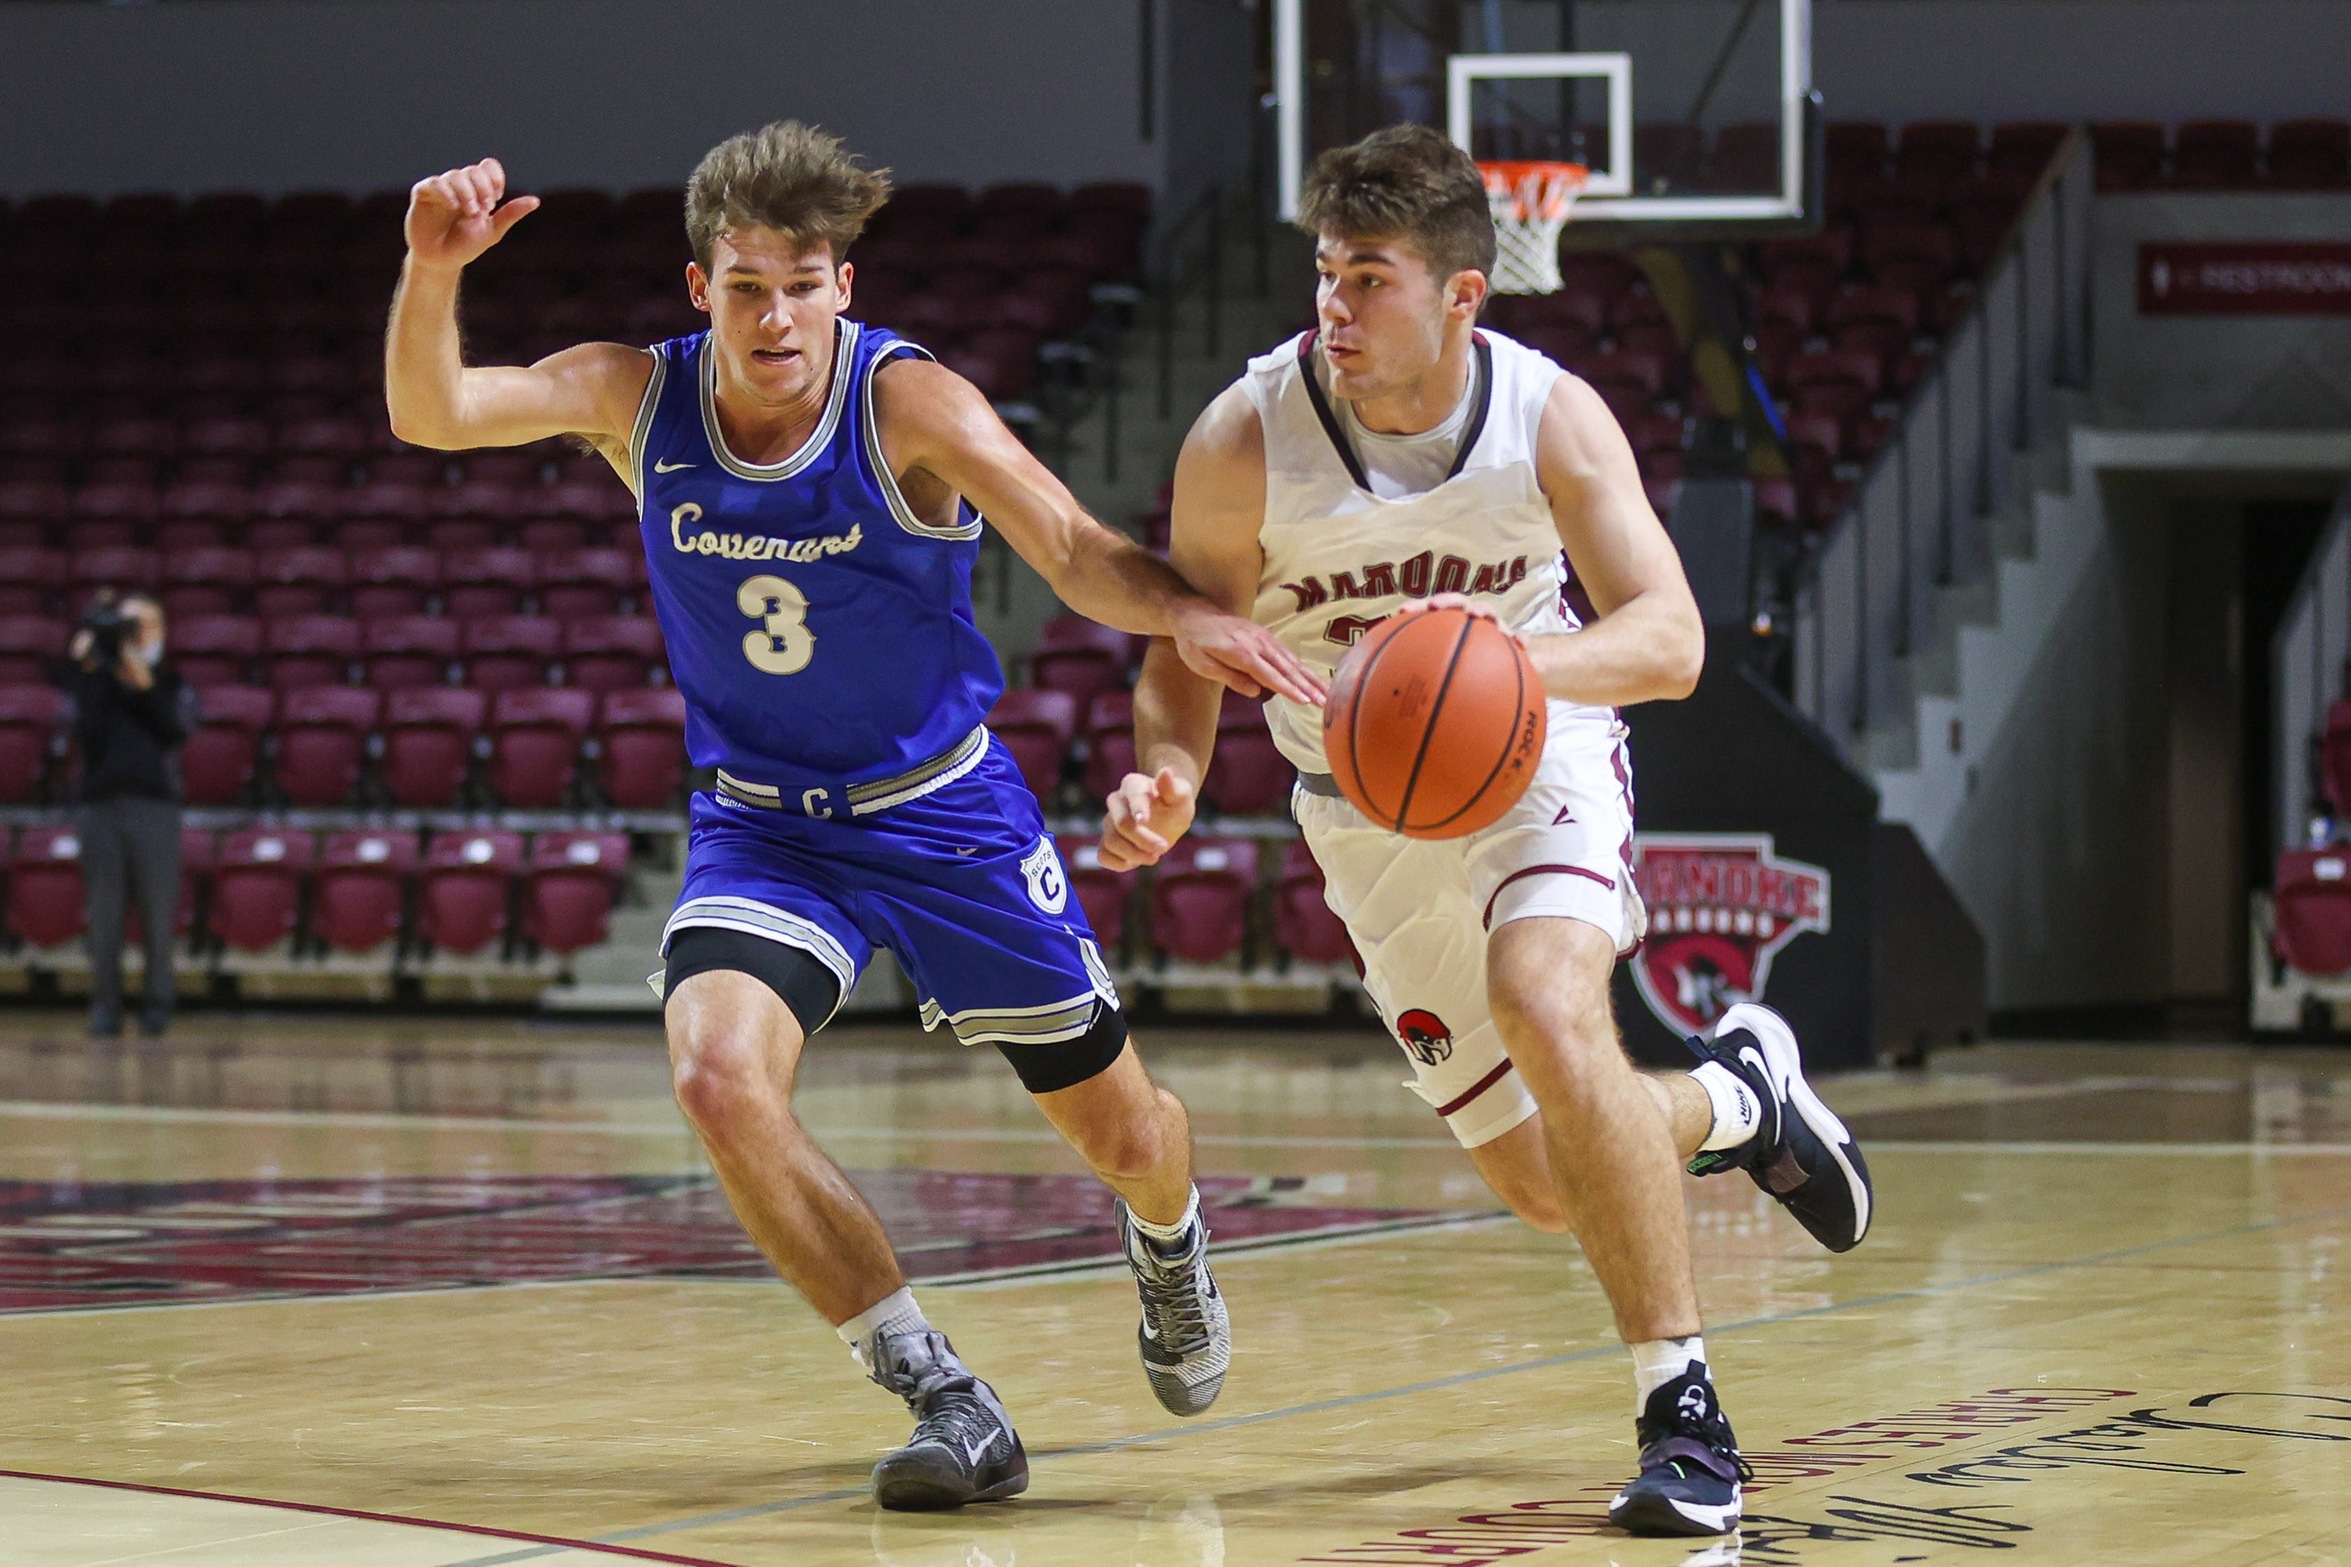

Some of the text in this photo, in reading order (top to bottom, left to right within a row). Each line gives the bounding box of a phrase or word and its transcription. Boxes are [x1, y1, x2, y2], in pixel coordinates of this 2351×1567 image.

[671, 502, 863, 563] Covenant
[737, 575, 817, 675] 3
[802, 787, 833, 820] C
[1040, 866, 1060, 901] C
